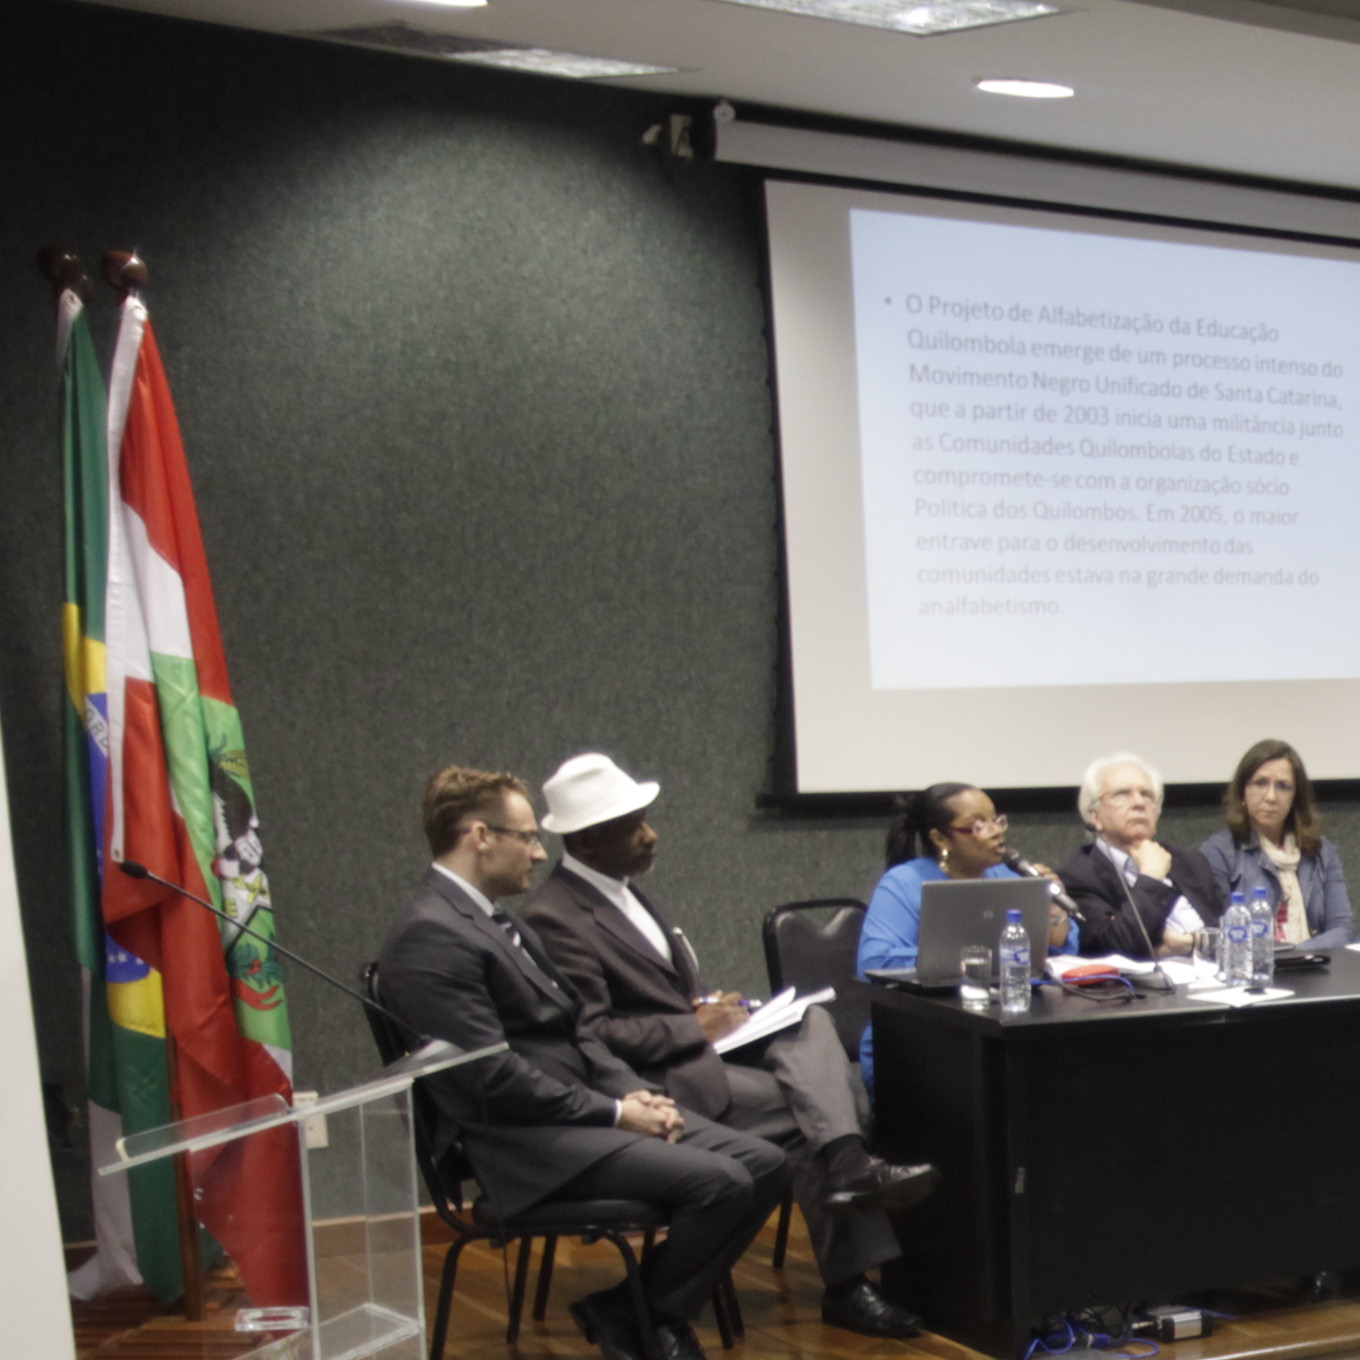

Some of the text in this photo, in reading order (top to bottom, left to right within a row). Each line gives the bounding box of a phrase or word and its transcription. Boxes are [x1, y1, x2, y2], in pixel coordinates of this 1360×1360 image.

[904, 293, 1280, 345] O Projeto de Alfabetização da Educação
[906, 327, 1344, 379] Quilombola emerge de um processo intenso do
[908, 362, 1342, 412] Movimento Negro Unificado de Santa Catarina,
[909, 400, 951, 421] que
[954, 403, 967, 419] a
[971, 402, 1028, 423] partir
[1032, 403, 1058, 424] de
[1063, 404, 1110, 426] 2003
[1114, 411, 1163, 429] inicia
[1167, 414, 1208, 431] uma
[1298, 419, 1345, 441] junto
[911, 431, 1300, 467] as Comunidades Quilombolas do Estado e
[912, 468, 1291, 498] compromete-se com a organização sócio
[992, 498, 1029, 520] dos
[1145, 502, 1175, 523] Em
[1179, 503, 1230, 528] 2005,
[1232, 509, 1246, 525] o
[1248, 508, 1299, 526] maior
[915, 532, 1254, 555] entrave para o desenvolvimento das
[916, 564, 1321, 590] comunidades estava na grande demanda do
[918, 595, 1065, 616] analfabetismo.
